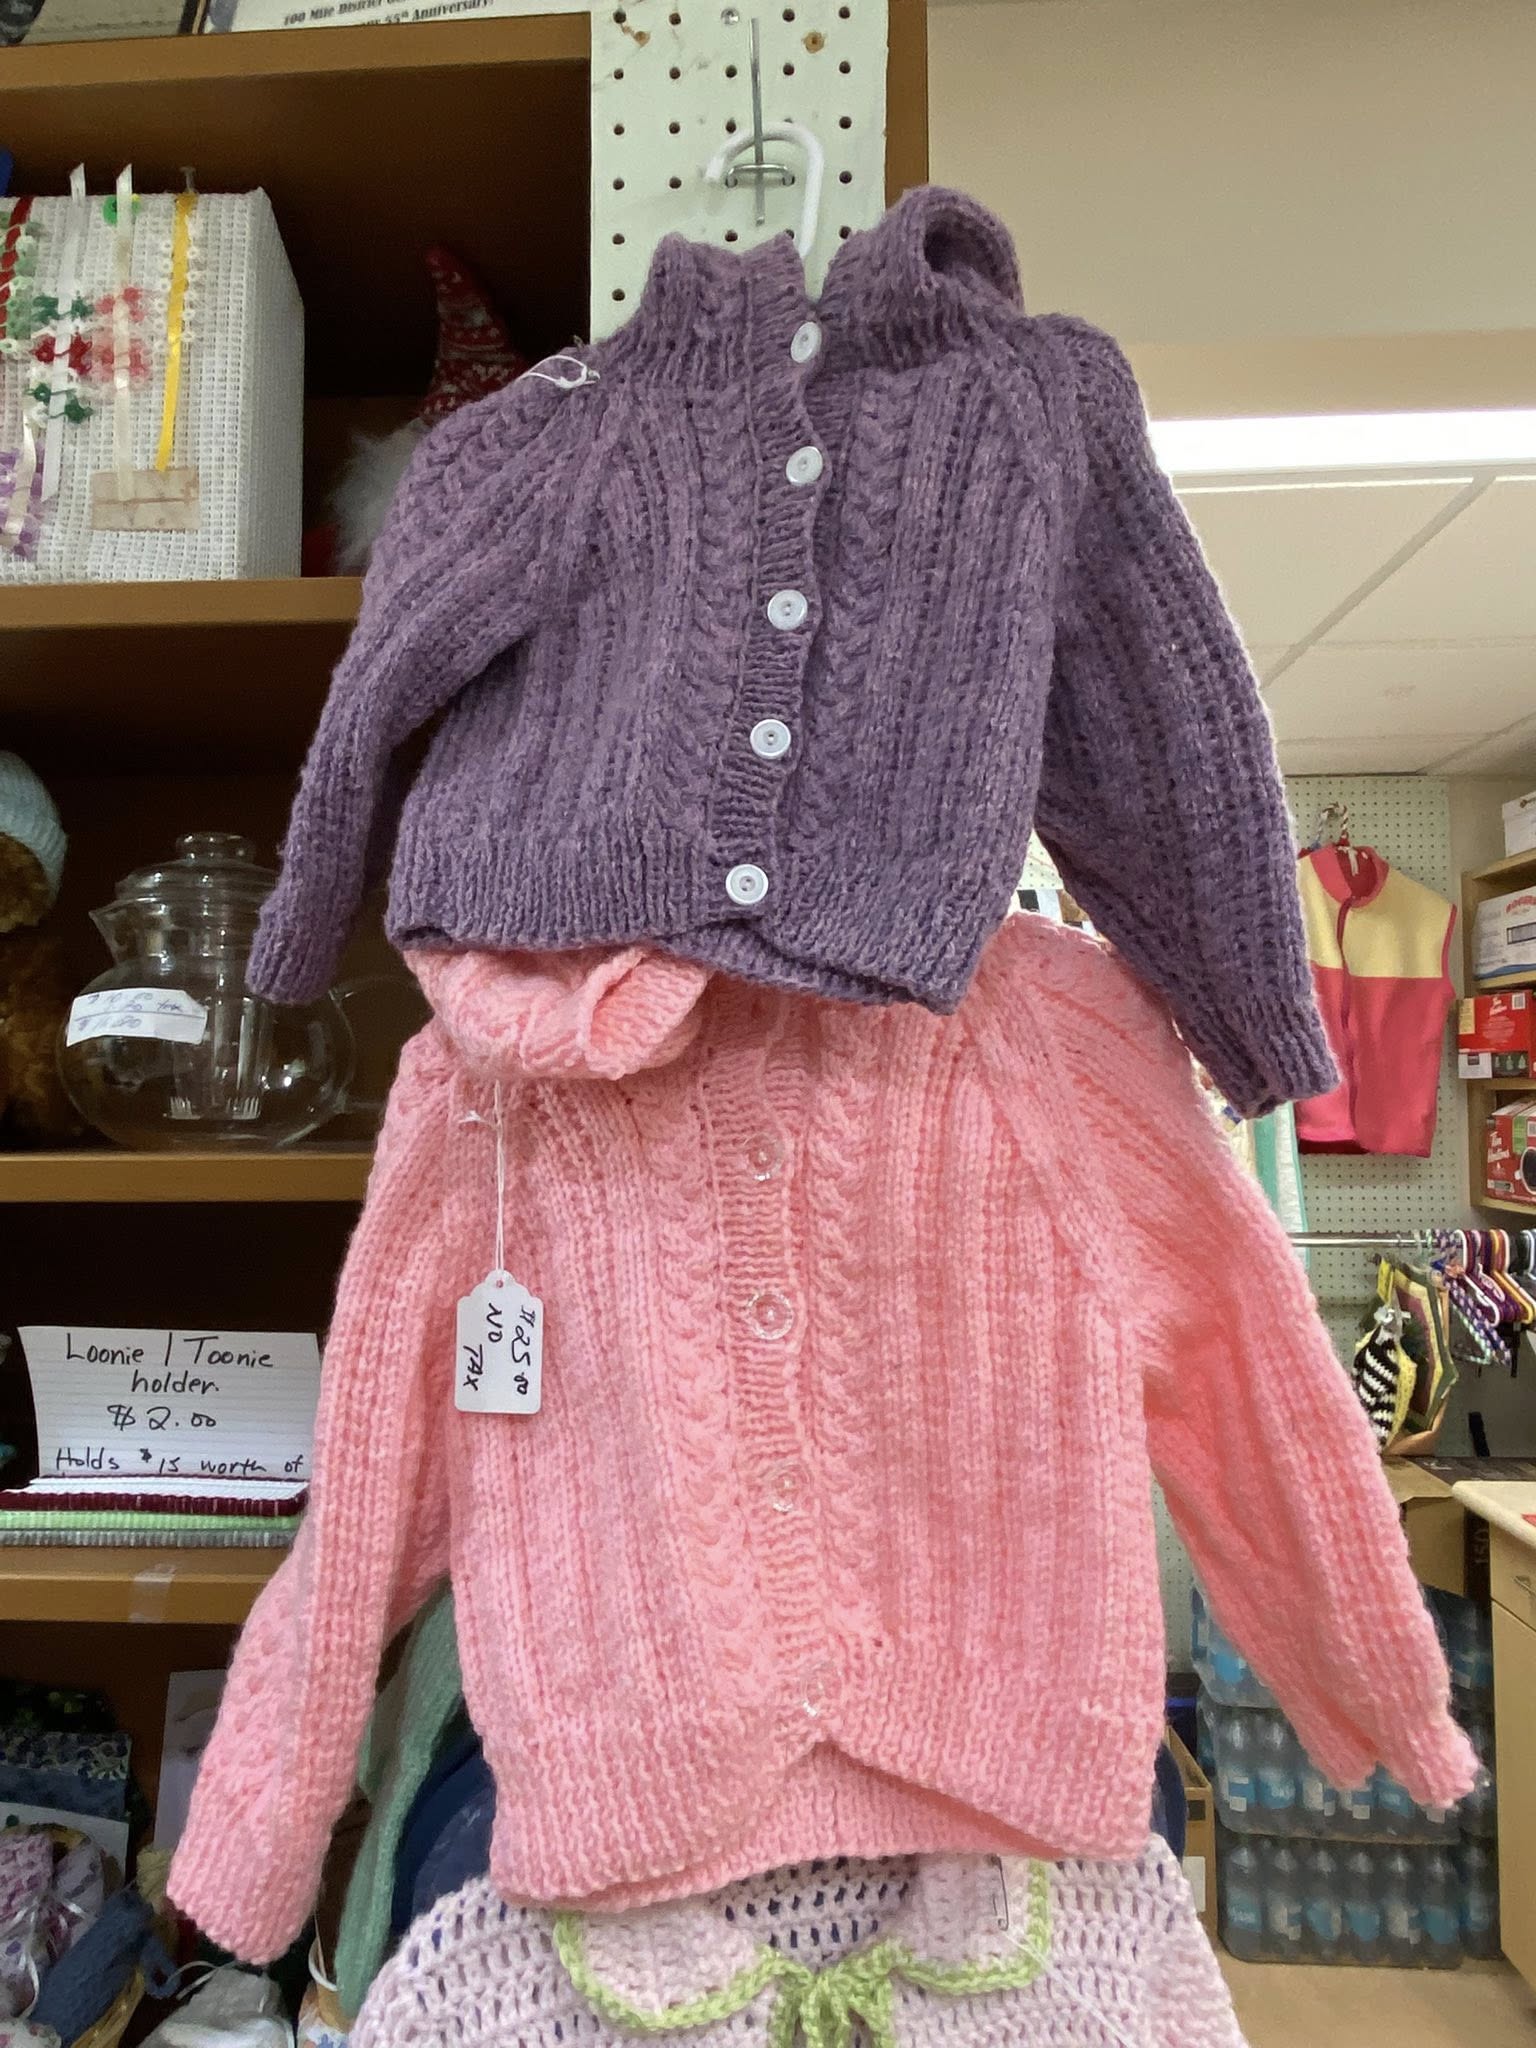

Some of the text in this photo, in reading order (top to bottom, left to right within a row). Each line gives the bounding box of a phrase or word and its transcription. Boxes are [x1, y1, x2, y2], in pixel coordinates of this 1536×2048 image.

[284, 11, 306, 26] 100
[310, 6, 335, 20] Mile
[486, 1302, 503, 1343] NO
[66, 1332, 145, 1364] Loonie
[183, 1335, 274, 1368] Toonie
[462, 1343, 484, 1391] TAX
[56, 1447, 120, 1470] Holds
[201, 1458, 268, 1475] worth
[283, 1454, 304, 1474] of
